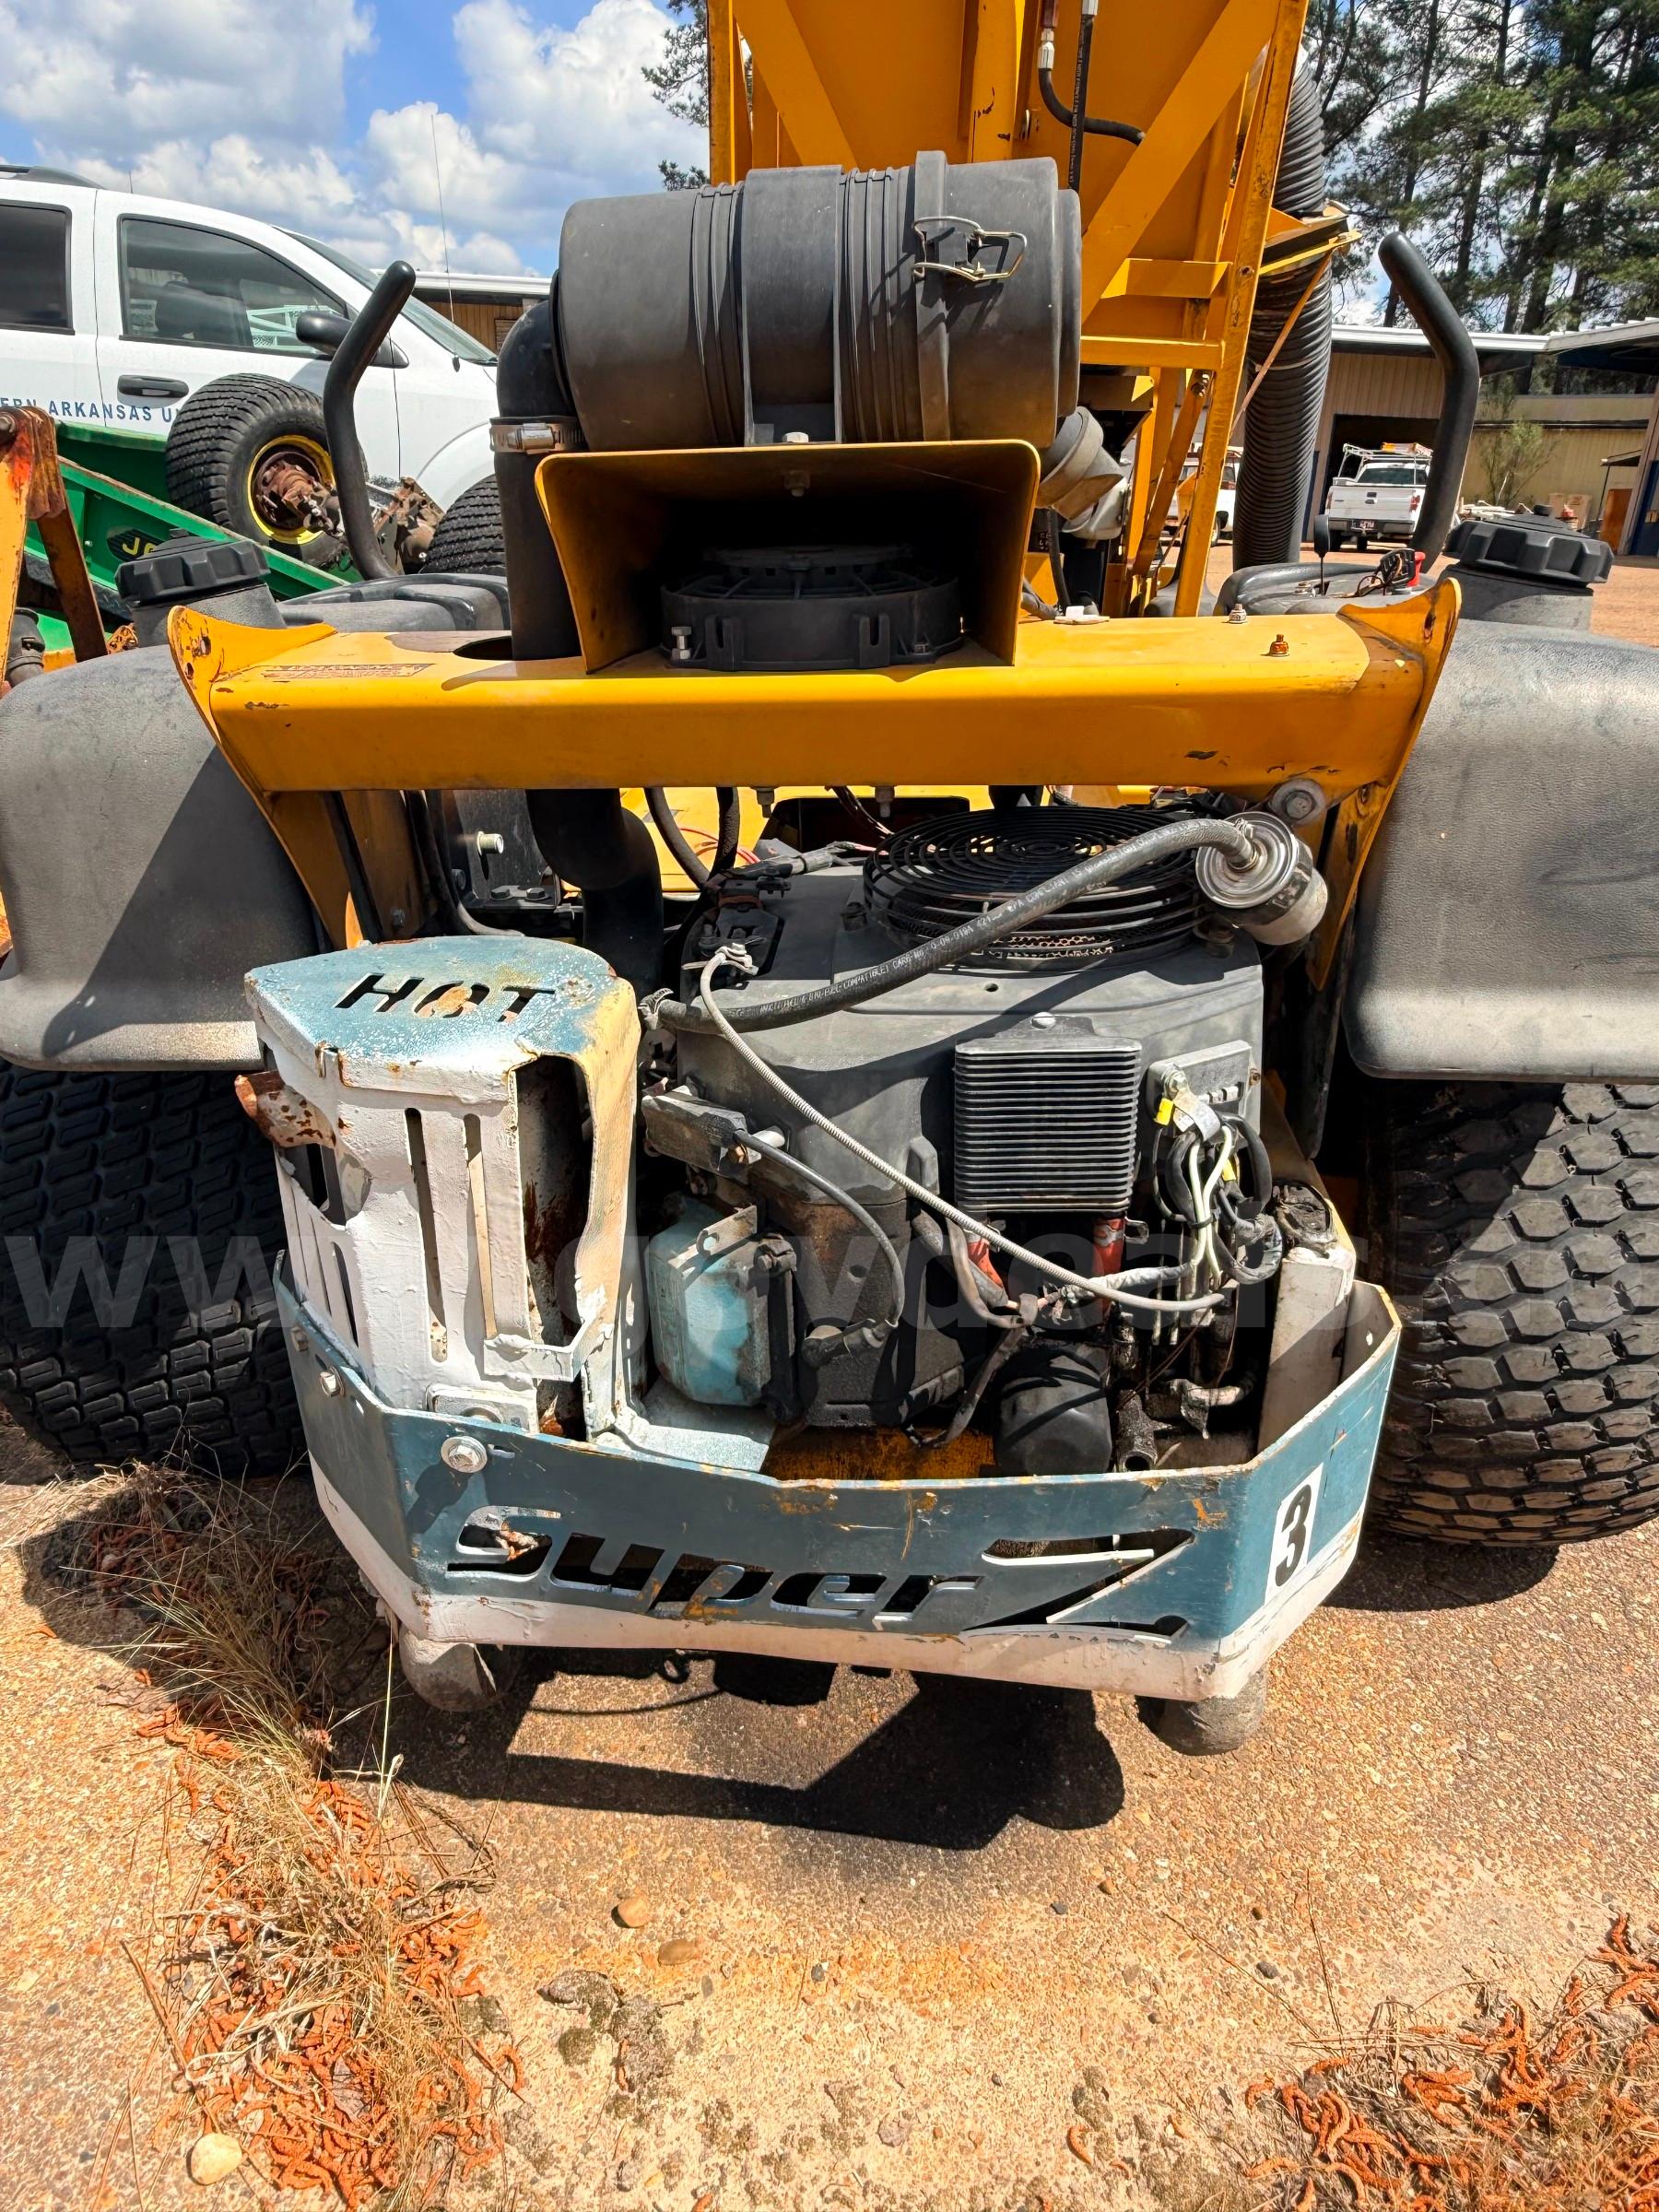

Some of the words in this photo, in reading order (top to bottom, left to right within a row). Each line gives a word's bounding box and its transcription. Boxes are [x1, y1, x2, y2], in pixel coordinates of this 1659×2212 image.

[49, 400, 151, 421] ARKANSAS
[161, 407, 181, 423] U
[334, 972, 556, 1023] HOT
[1275, 1484, 1312, 1586] 3
[446, 1505, 984, 1628] Super
[962, 1527, 1194, 1645] Z
